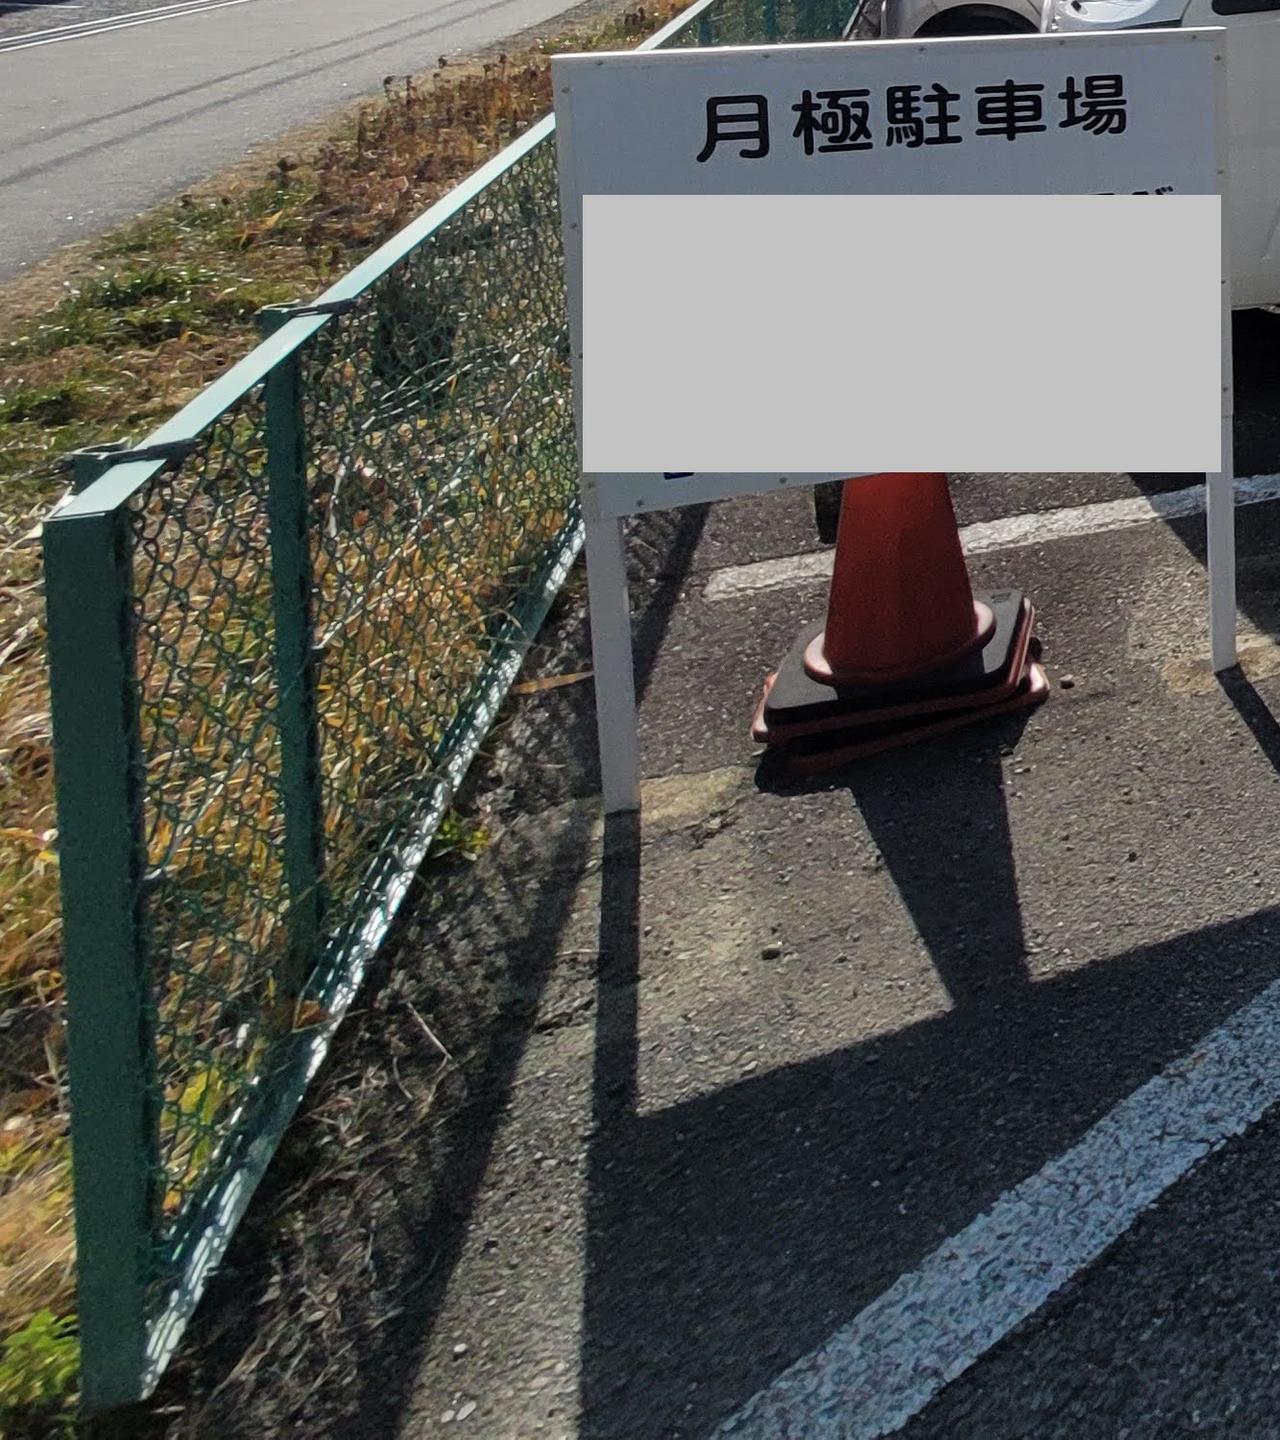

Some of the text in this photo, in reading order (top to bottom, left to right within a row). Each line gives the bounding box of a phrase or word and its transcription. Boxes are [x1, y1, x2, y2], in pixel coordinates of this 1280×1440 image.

[697, 74, 1127, 162] 月極駐車場
